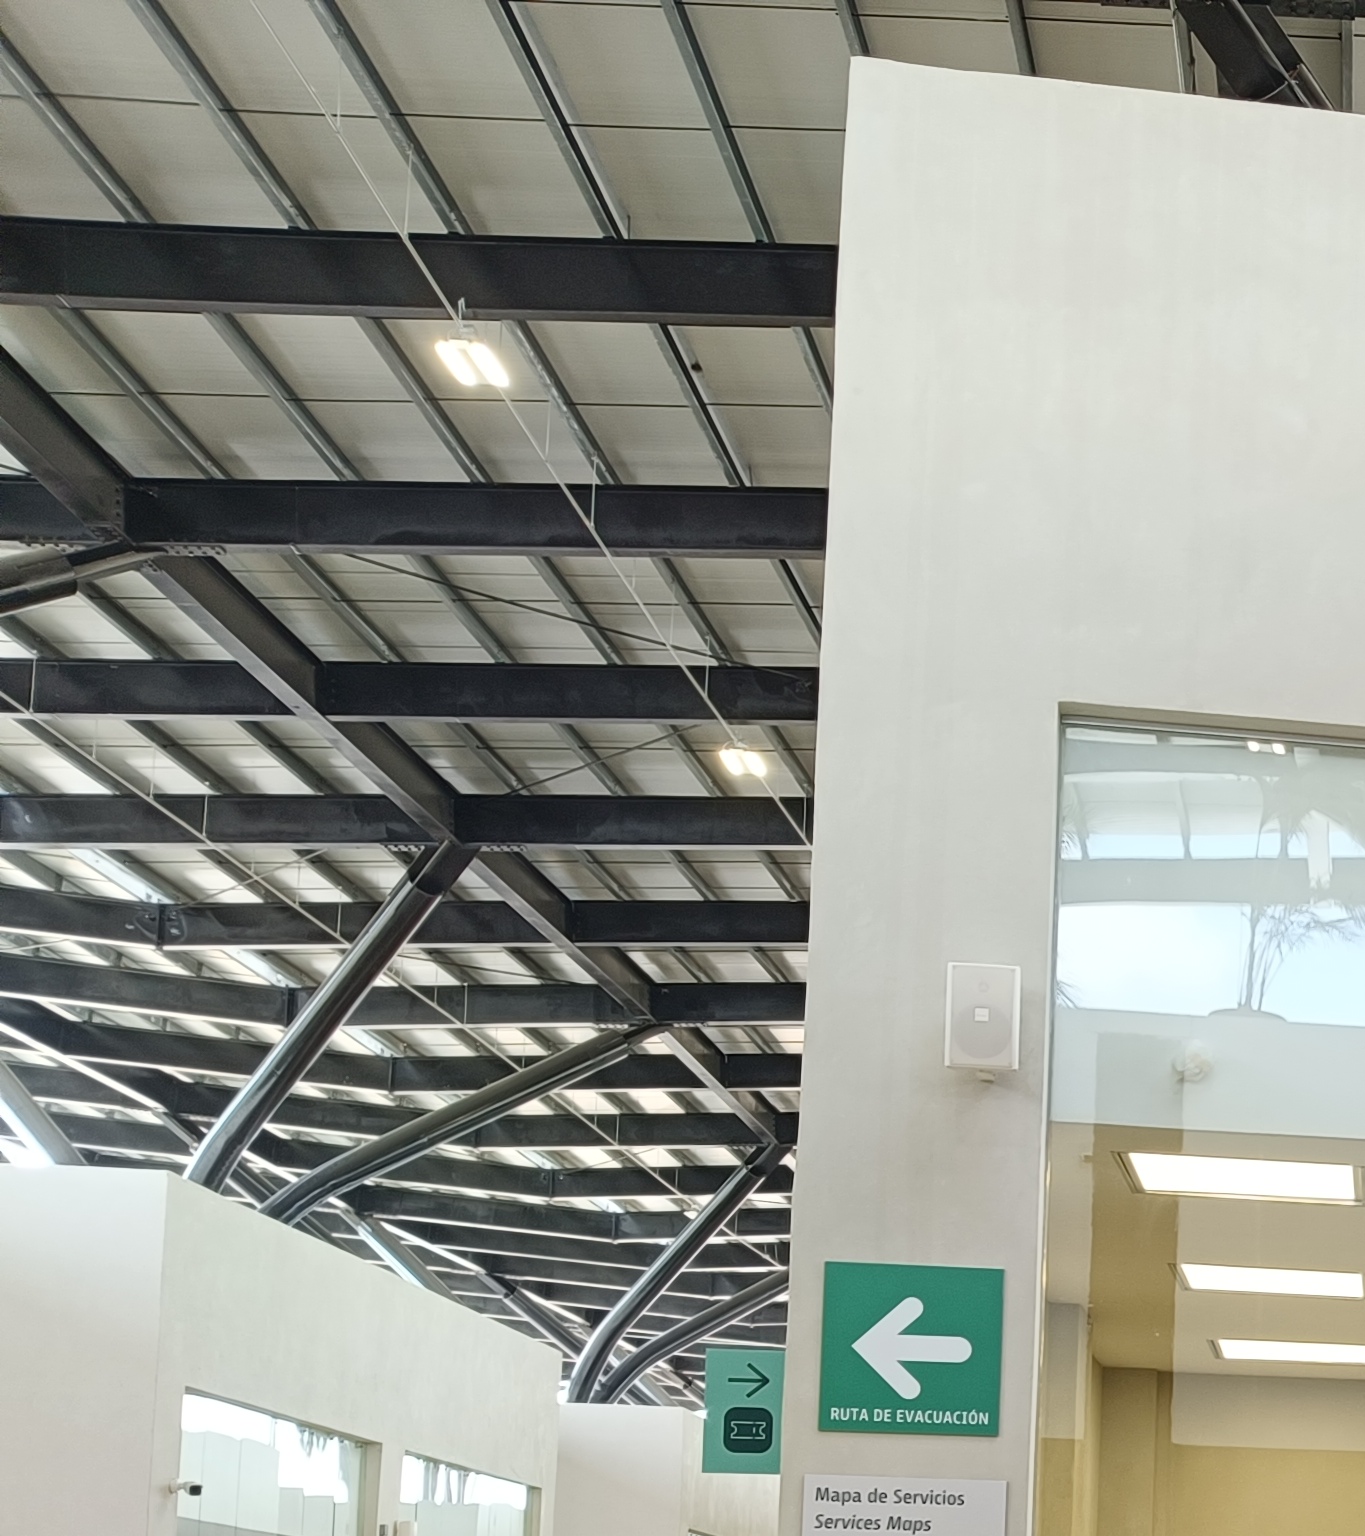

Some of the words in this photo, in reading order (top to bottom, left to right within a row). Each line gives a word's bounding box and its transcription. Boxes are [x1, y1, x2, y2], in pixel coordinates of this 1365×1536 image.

[830, 1407, 869, 1421] RUTA
[873, 1409, 892, 1422] DE
[896, 1409, 989, 1425] EVACUACIÓN
[815, 1487, 862, 1506] Mapa
[867, 1488, 888, 1503] de
[893, 1489, 965, 1506] Servicios
[814, 1514, 881, 1531] Services
[886, 1516, 932, 1535] Maps
